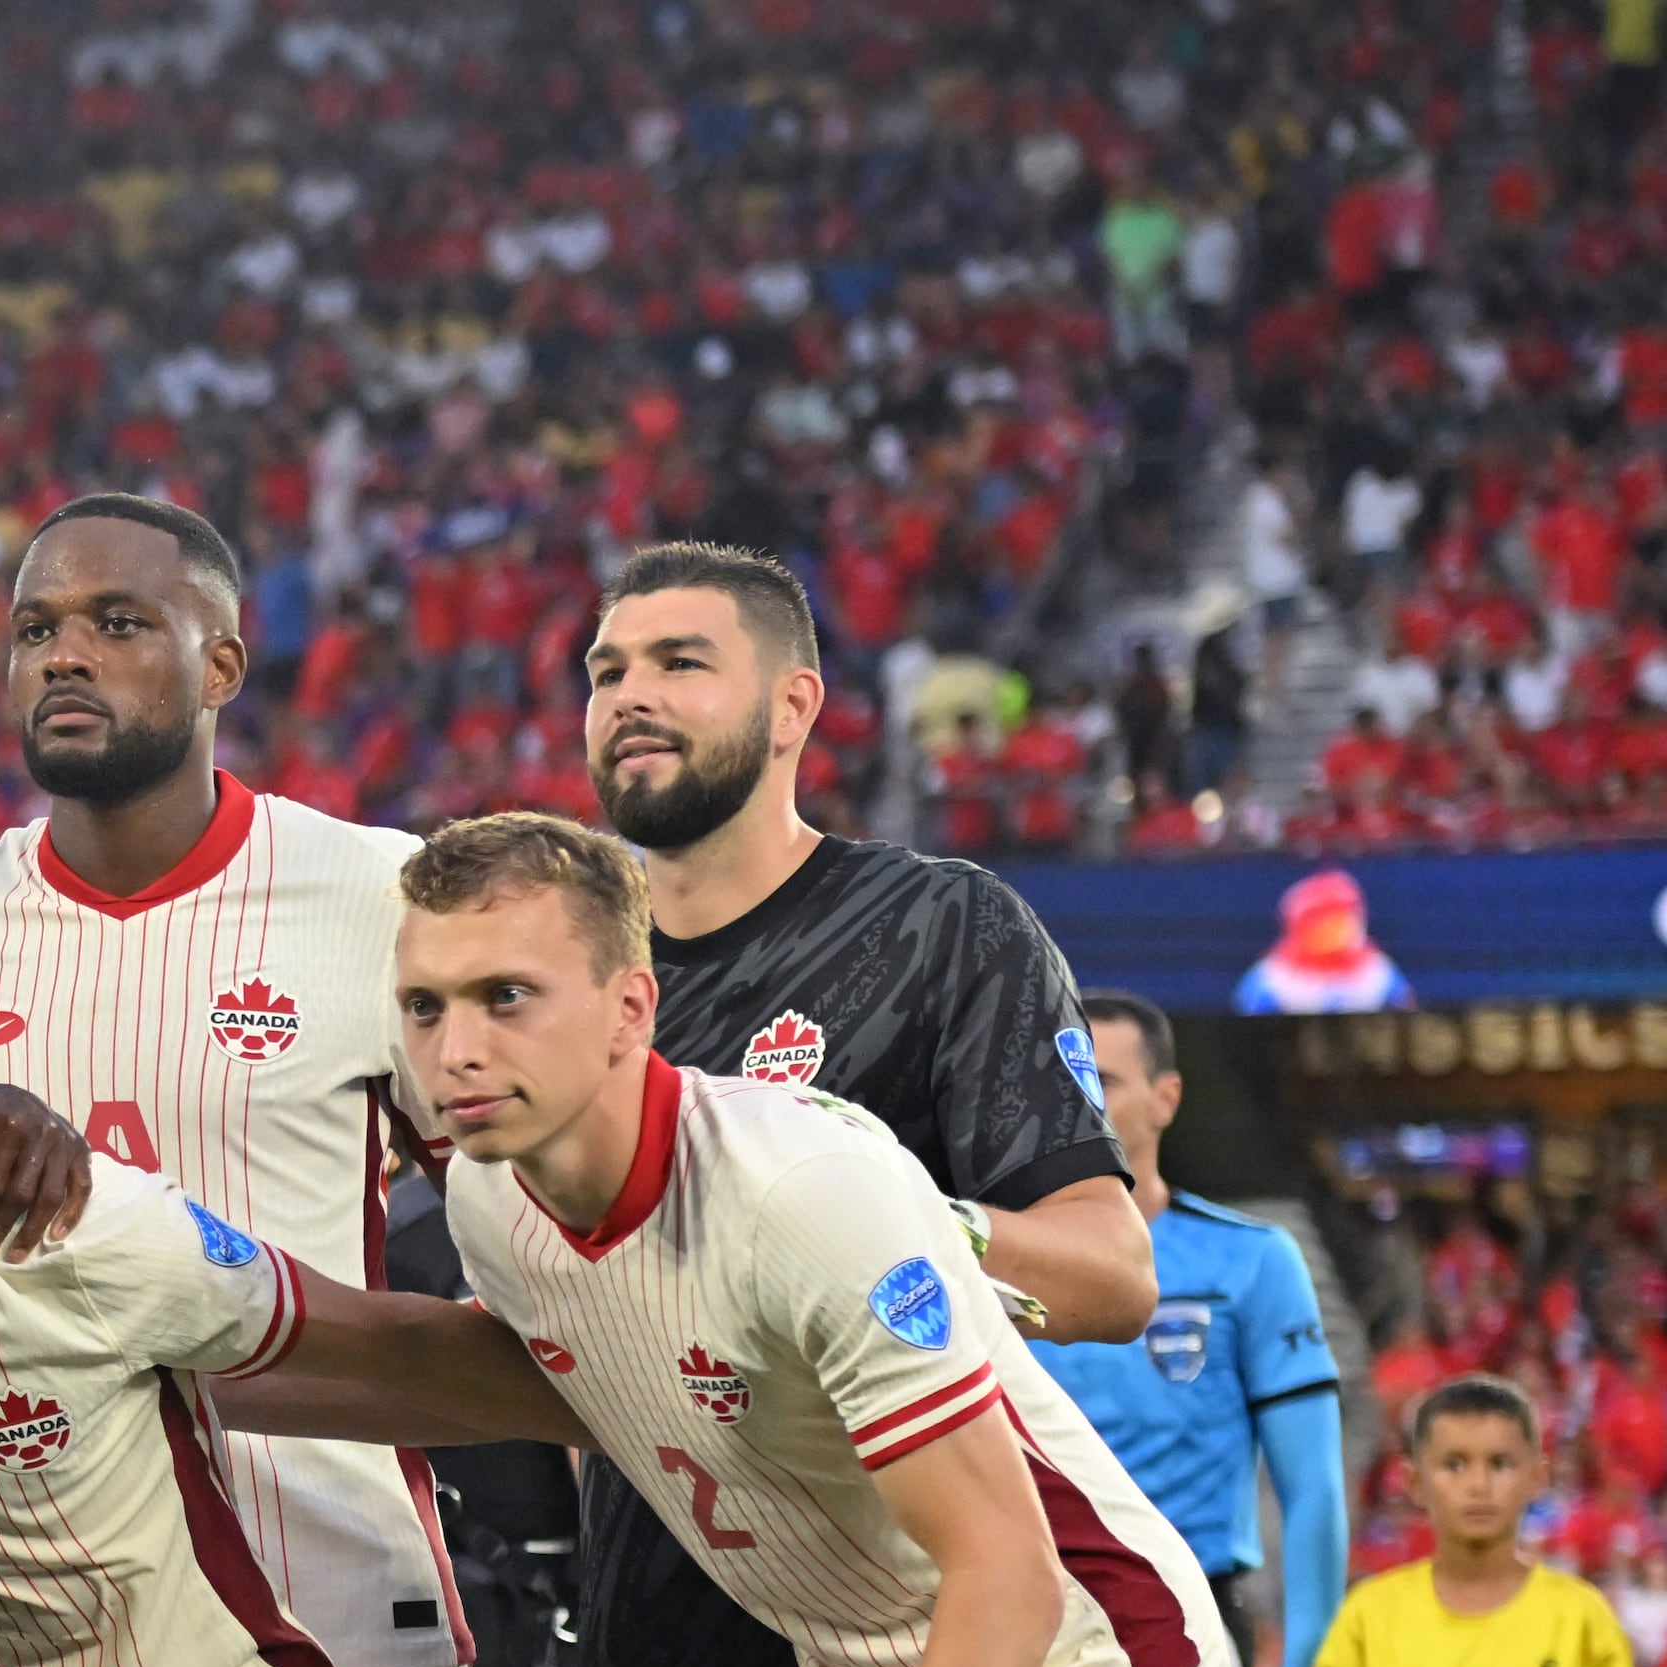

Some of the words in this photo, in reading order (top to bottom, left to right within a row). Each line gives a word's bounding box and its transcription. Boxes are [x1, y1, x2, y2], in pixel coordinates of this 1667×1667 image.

[210, 1012, 299, 1029] CANADA
[746, 1048, 819, 1068] CANADA
[888, 1277, 935, 1316] ROCKING
[682, 1378, 748, 1391] CANADA
[655, 1446, 757, 1549] 2
